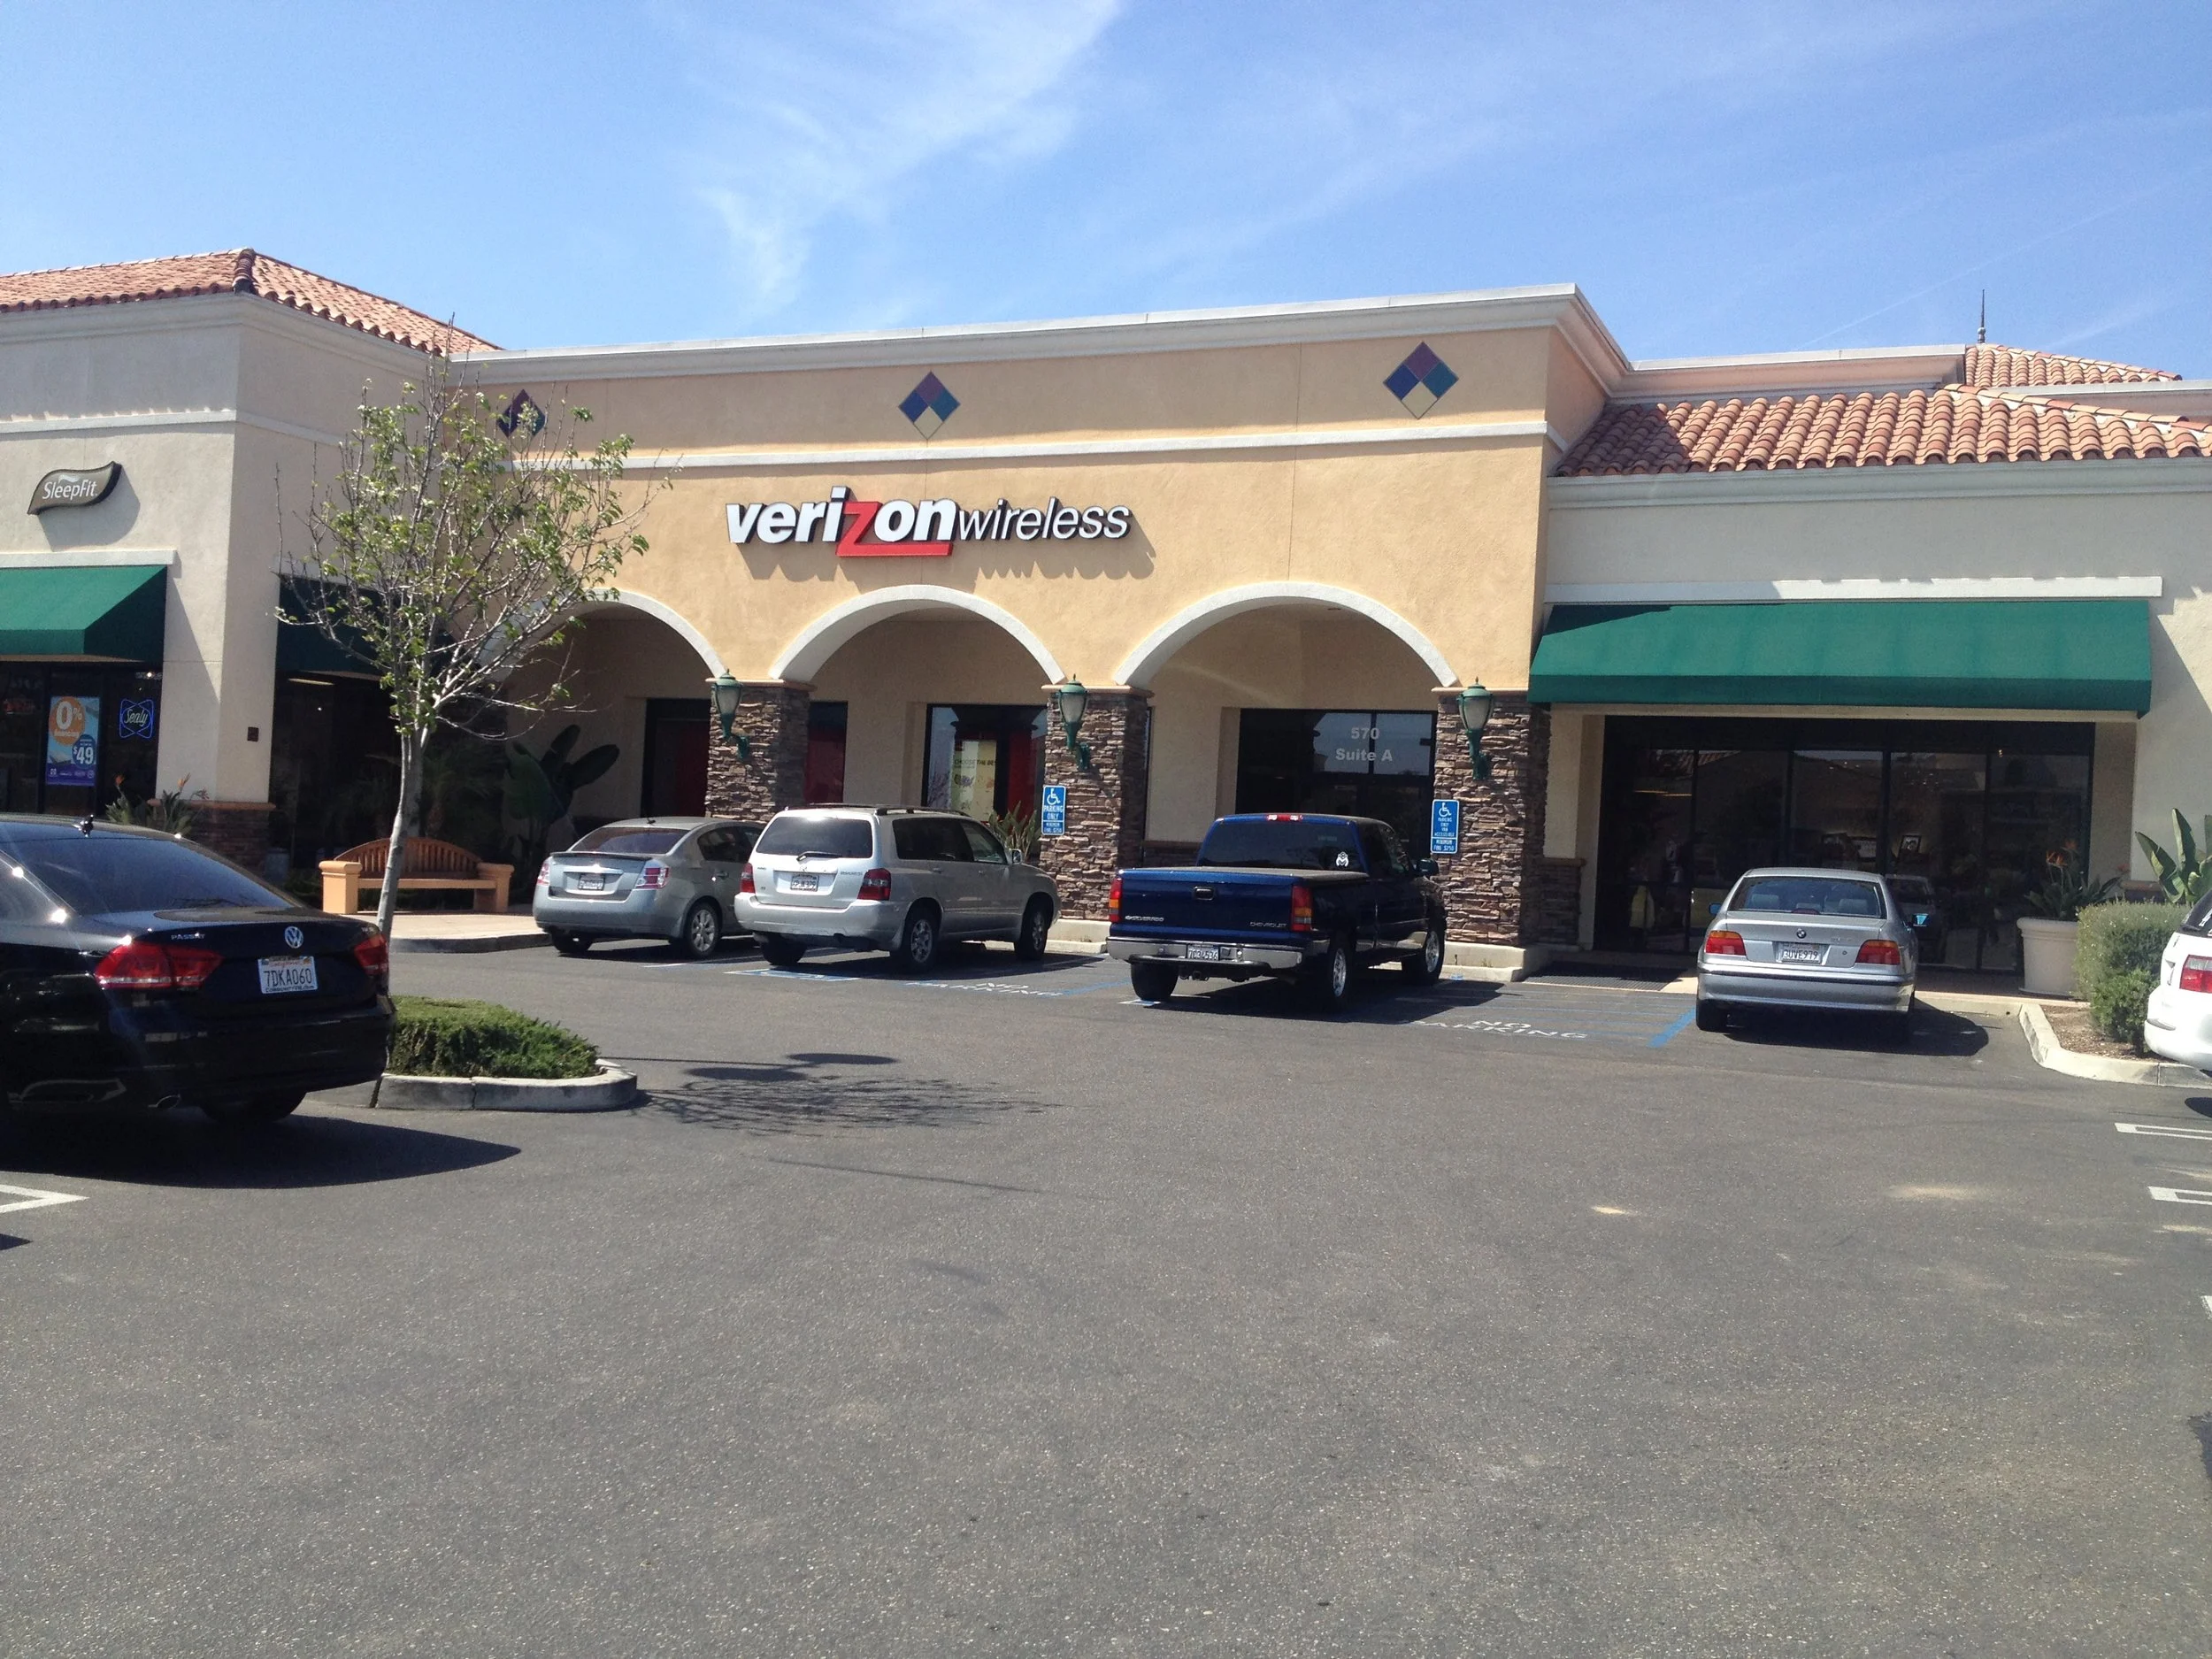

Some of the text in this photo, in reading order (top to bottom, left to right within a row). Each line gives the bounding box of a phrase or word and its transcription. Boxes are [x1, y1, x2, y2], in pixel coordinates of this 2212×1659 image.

[42, 480, 96, 501] SleepFit
[726, 486, 1132, 557] verizon wireless
[124, 709, 148, 726] Sealy
[1351, 727, 1379, 740] 570
[73, 747, 94, 764] $49
[1335, 748, 1393, 761] Suite A
[264, 969, 312, 987] 7DKA060
[1414, 1020, 1588, 1039] PARKING
